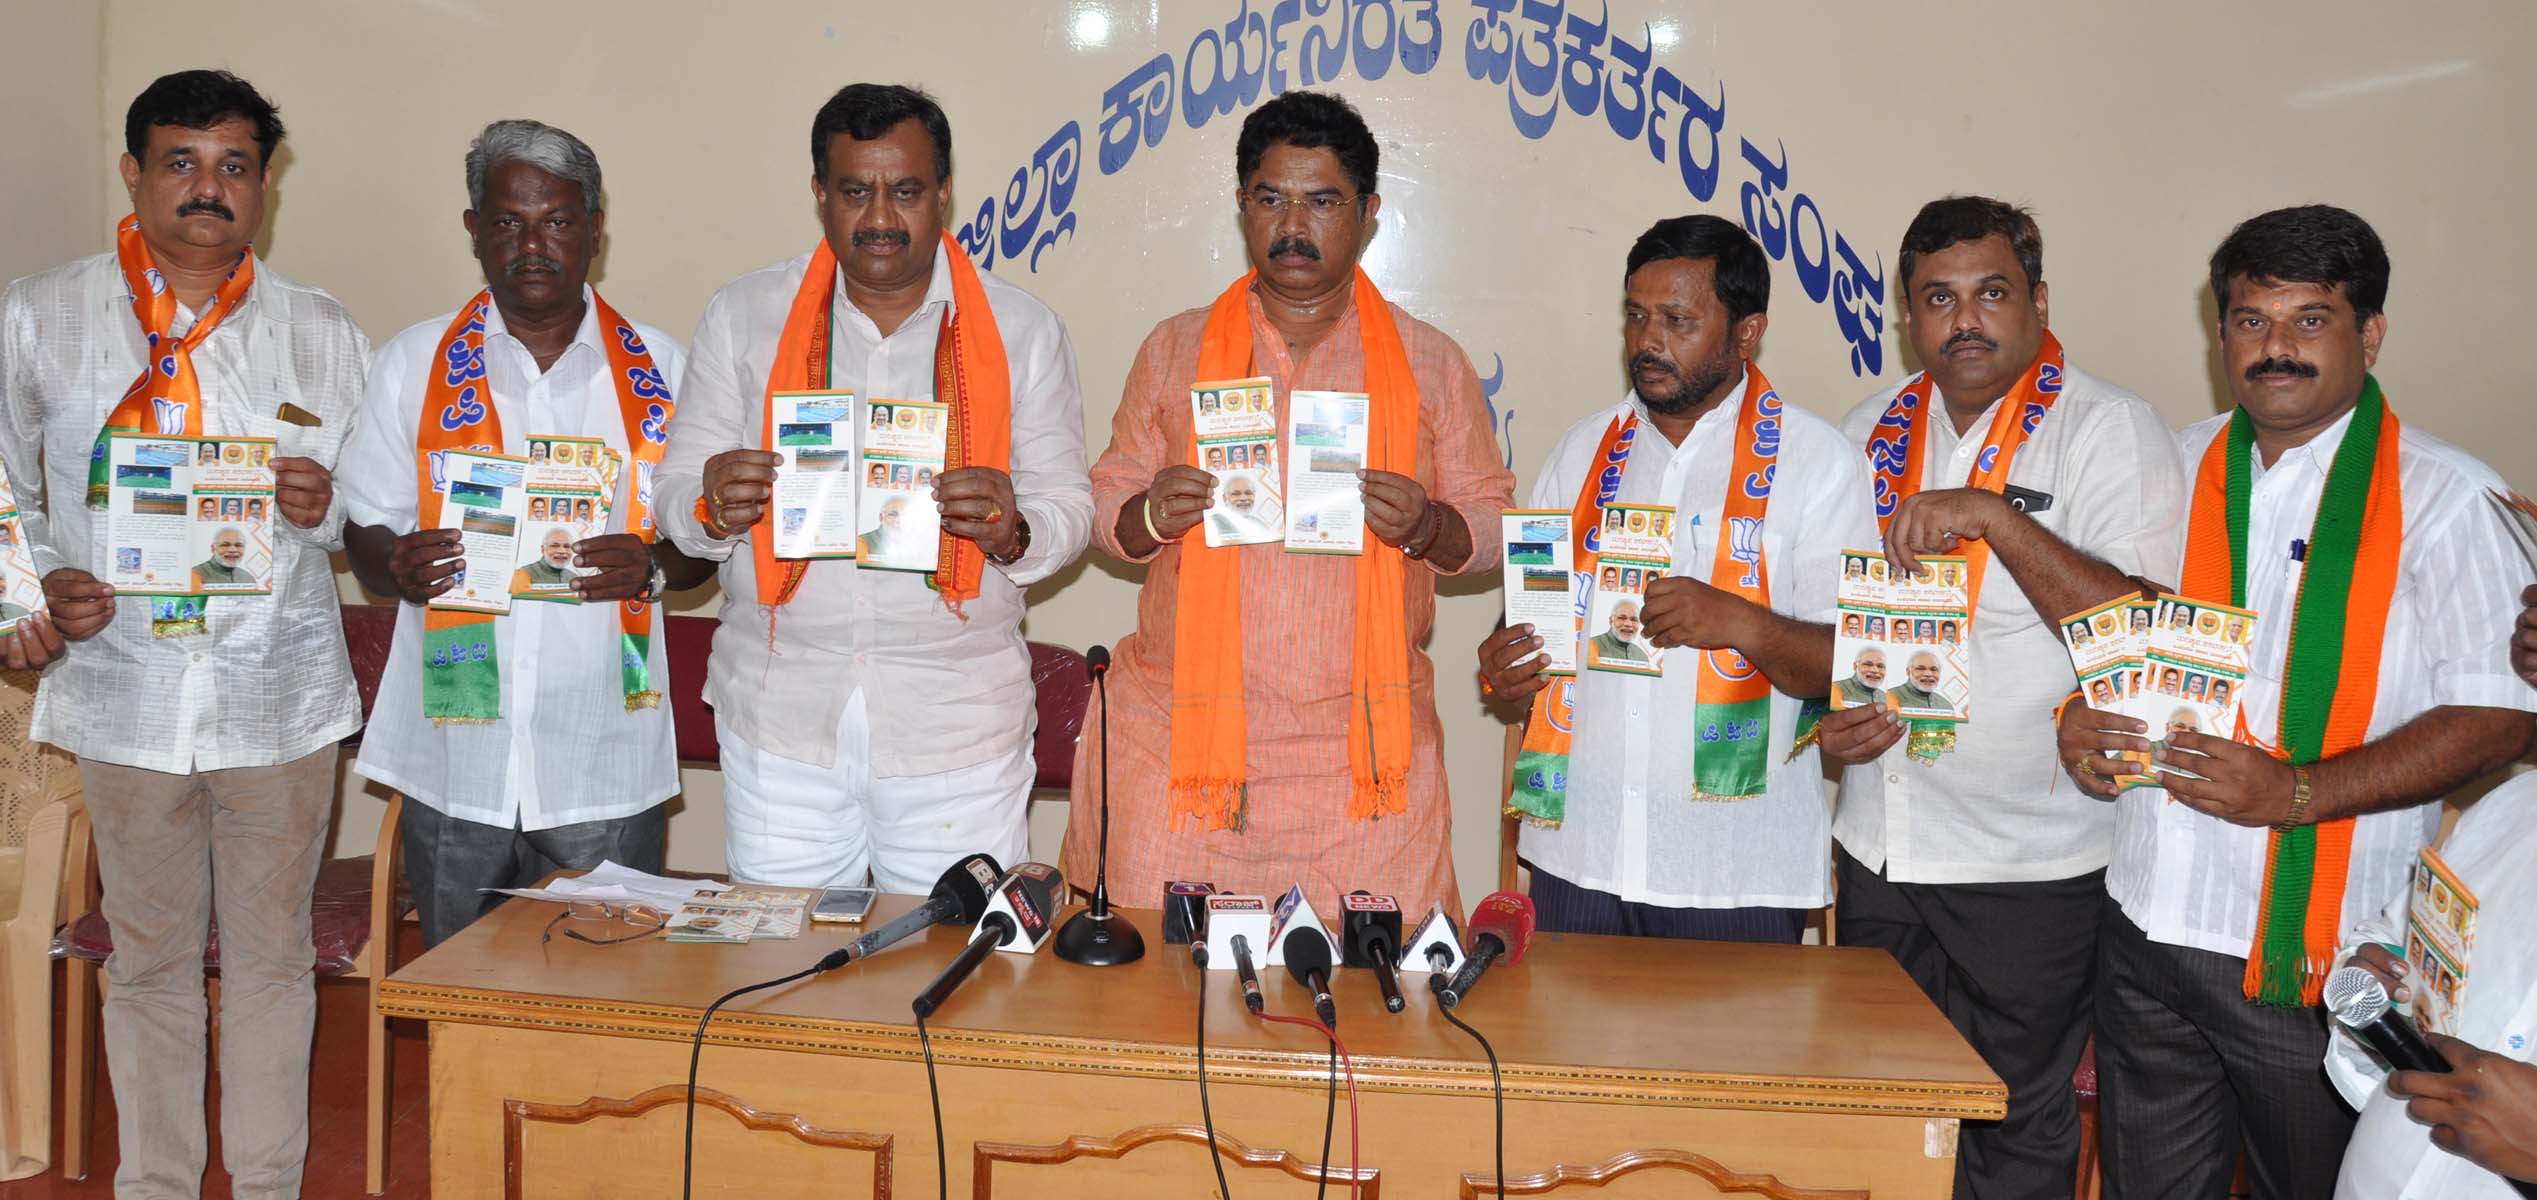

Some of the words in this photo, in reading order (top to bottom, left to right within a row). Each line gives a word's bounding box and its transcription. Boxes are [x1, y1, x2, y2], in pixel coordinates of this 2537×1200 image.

[1465, 0, 1725, 202] ಪತ್ರಕರ್ತರ
[1740, 136, 1885, 377] ಸಂಘ
[1350, 896, 1389, 904] DD
